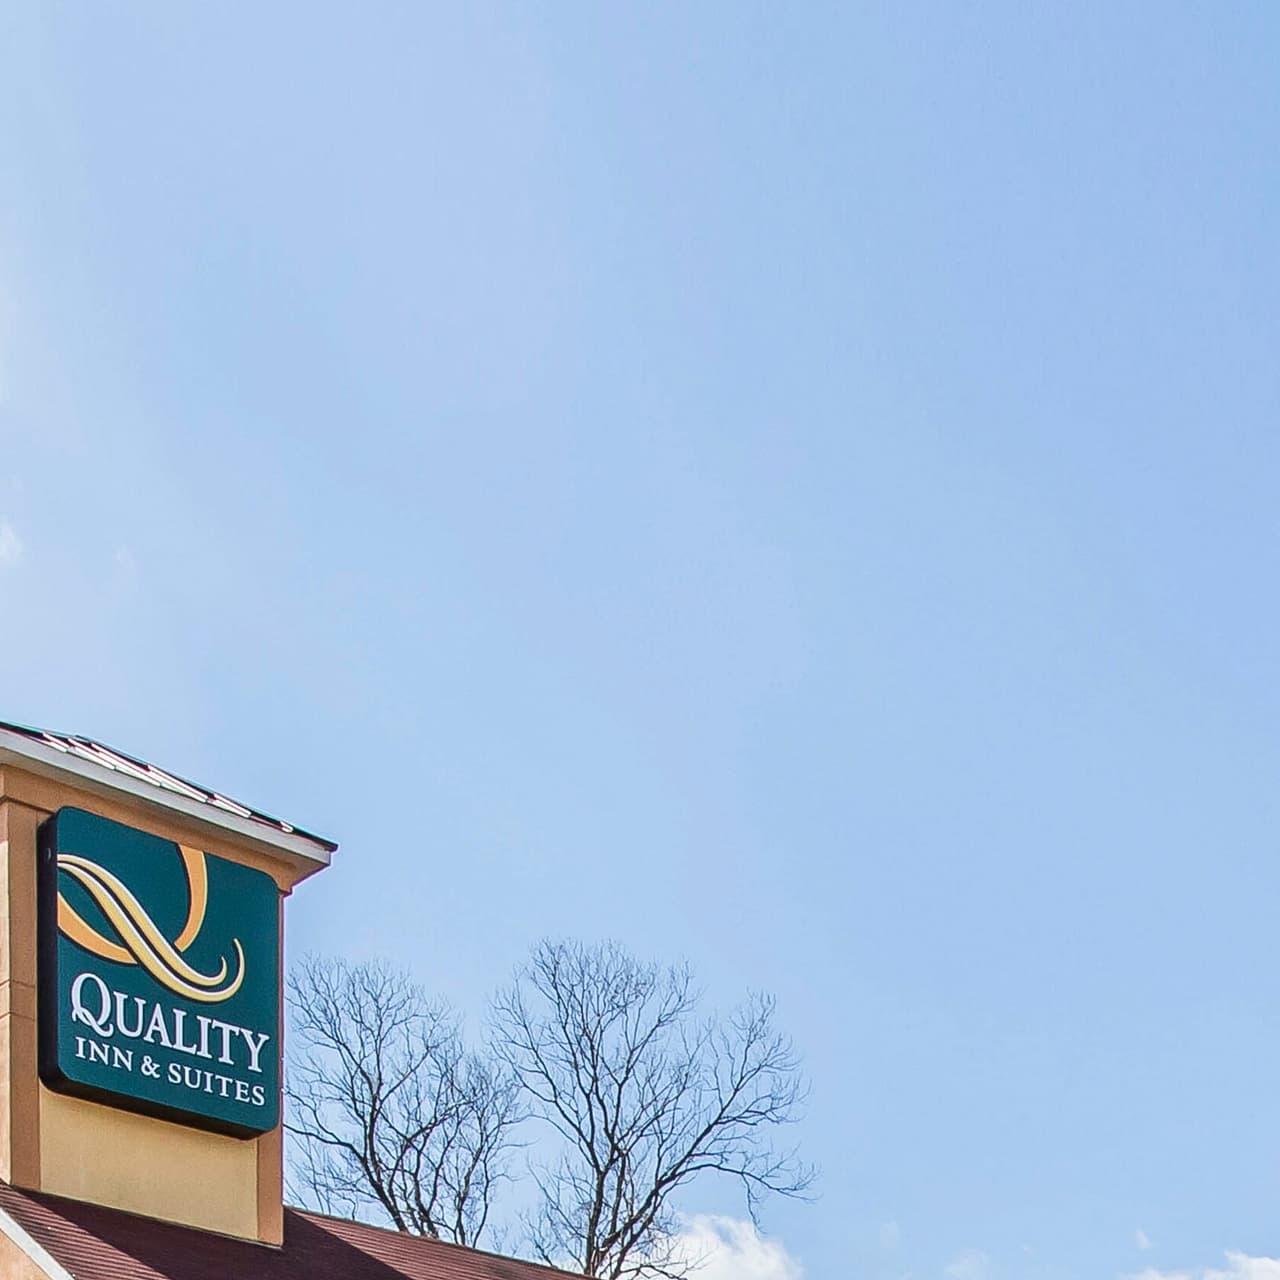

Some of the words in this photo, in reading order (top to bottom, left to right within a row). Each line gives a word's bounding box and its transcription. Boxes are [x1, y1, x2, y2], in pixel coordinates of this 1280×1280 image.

[72, 973, 270, 1072] QUALITY
[76, 1037, 133, 1071] INN
[141, 1055, 161, 1078] &
[168, 1063, 265, 1105] SUITES
